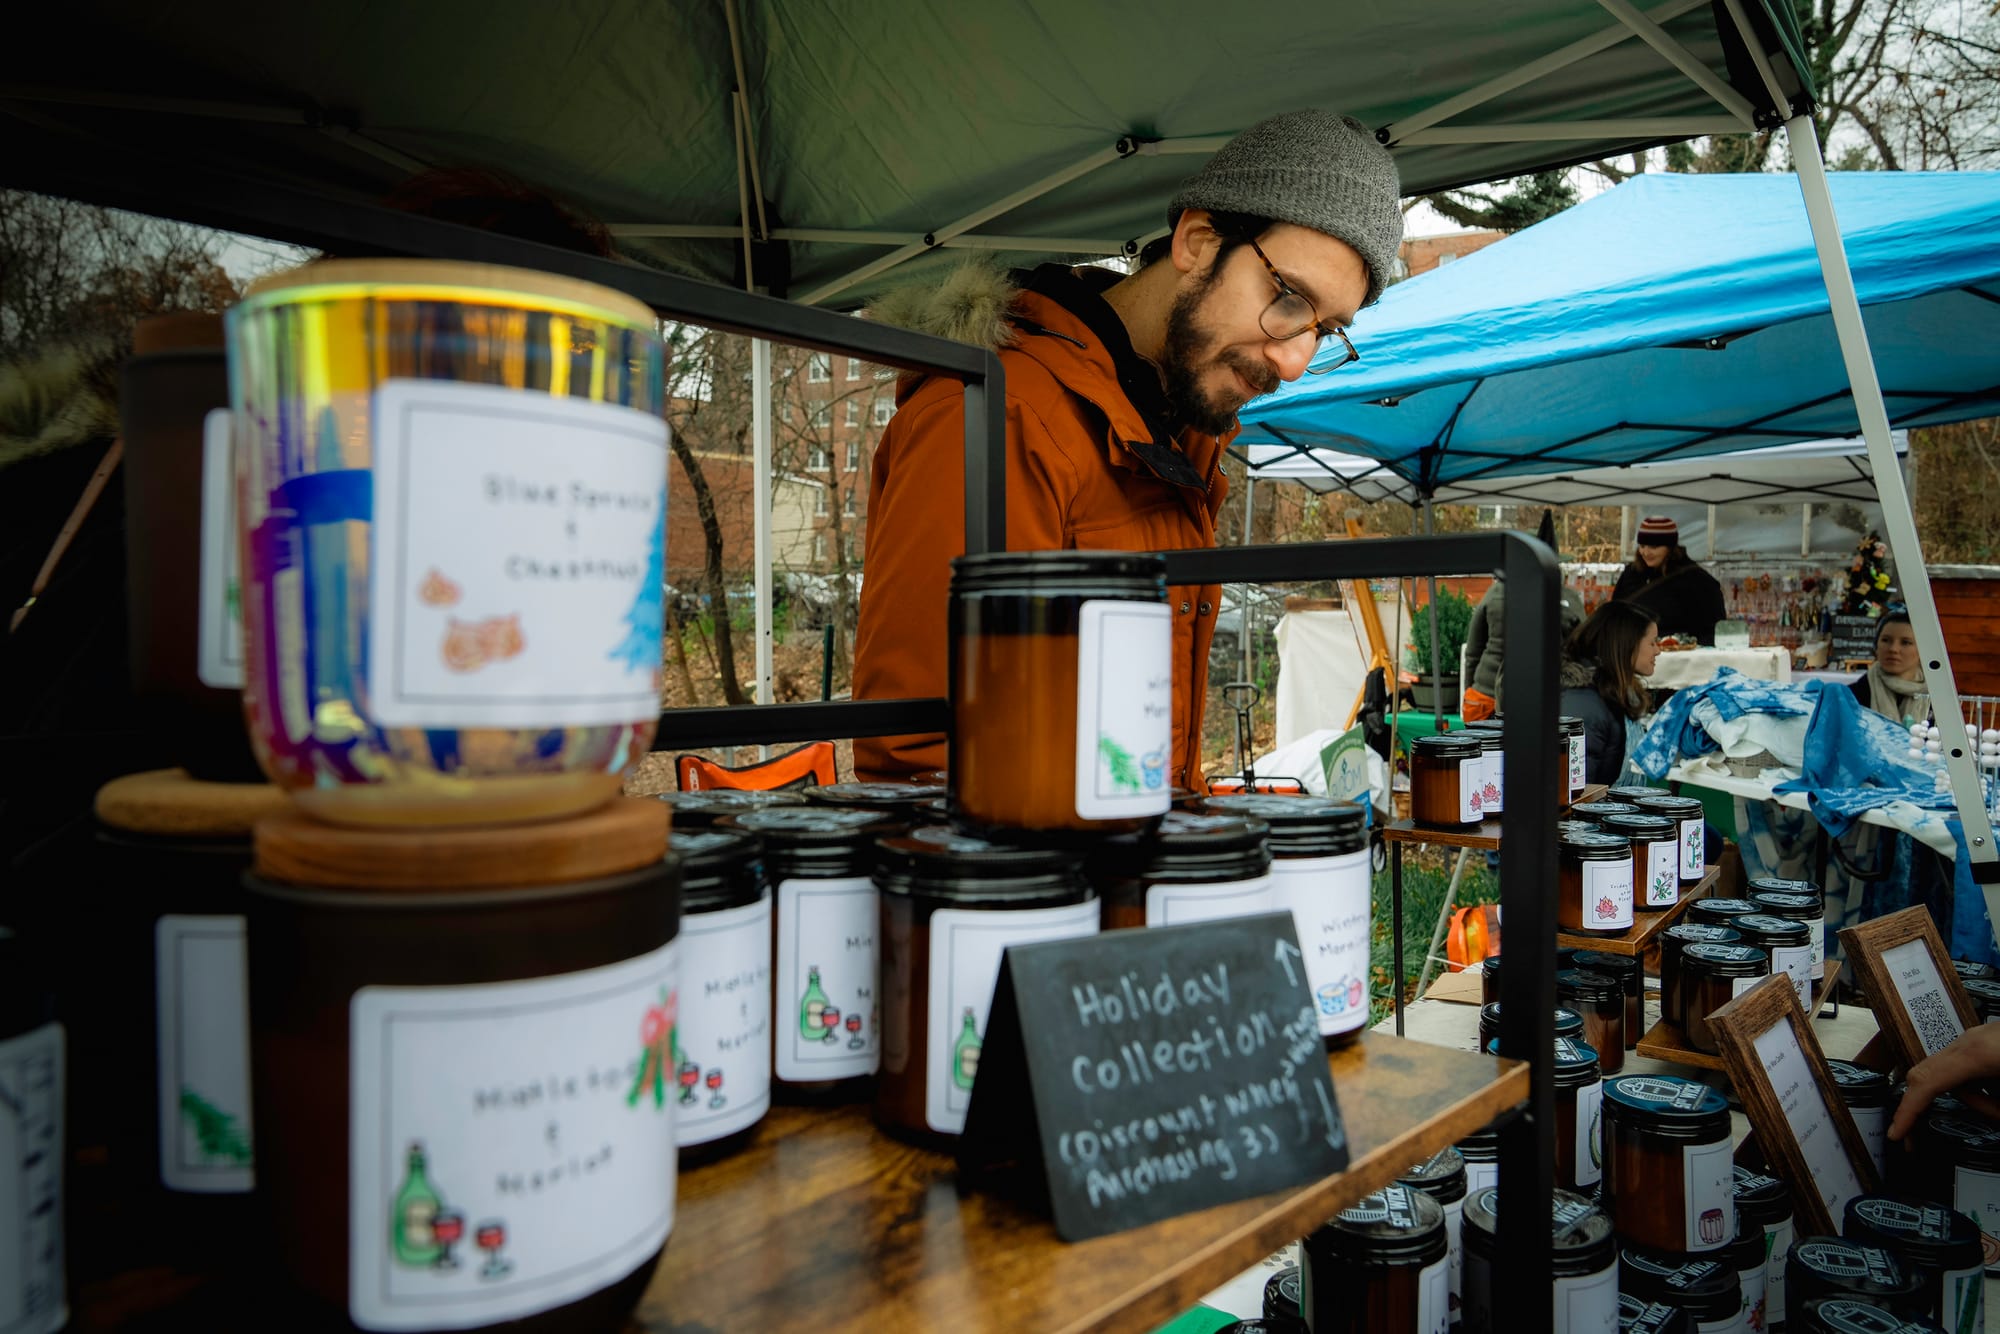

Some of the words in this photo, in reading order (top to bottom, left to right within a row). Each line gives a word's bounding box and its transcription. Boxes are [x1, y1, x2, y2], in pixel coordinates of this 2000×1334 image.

[1072, 962, 1231, 1028] Holiday
[1071, 1011, 1276, 1095] Collection
[1385, 1186, 1409, 1211] WICK
[1681, 1260, 1719, 1280] WICK
[1863, 1246, 1888, 1271] WICK
[1640, 1300, 1674, 1326] WICK
